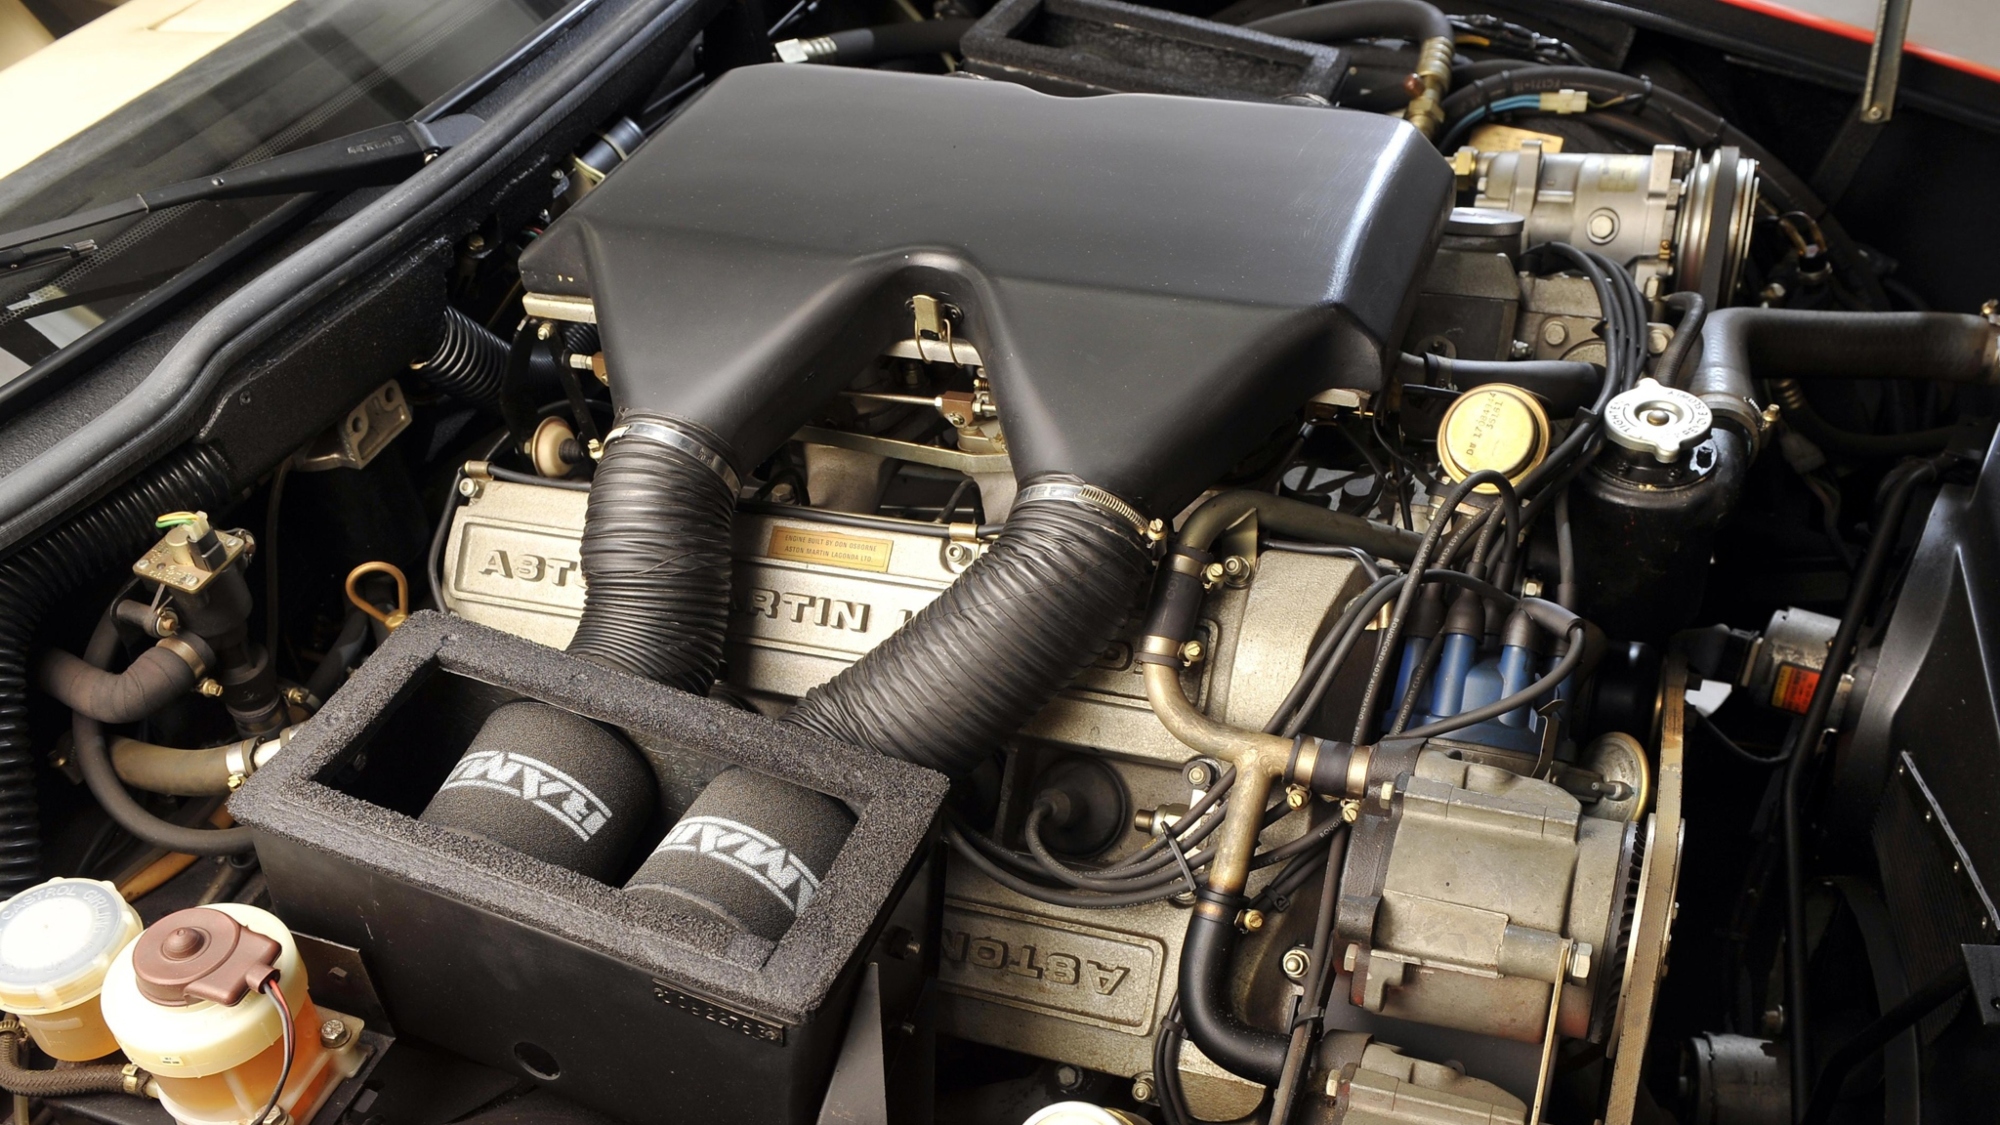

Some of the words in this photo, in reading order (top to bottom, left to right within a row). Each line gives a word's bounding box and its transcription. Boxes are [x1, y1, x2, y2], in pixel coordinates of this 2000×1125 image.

[785, 535, 806, 543] ENGINE
[808, 537, 824, 545] BUILT
[849, 543, 877, 552] OSBORNE
[785, 545, 804, 554] ASTON
[806, 548, 830, 556] MARTIN
[831, 551, 859, 560] LAGONDA
[478, 549, 590, 590] AST
[1378, 617, 1400, 661] BOUGICORD
[1358, 678, 1375, 720] AUTORADIO
[441, 751, 612, 842] RAM
[1, 884, 77, 920] CASTROL
[83, 889, 112, 934] GIRLING
